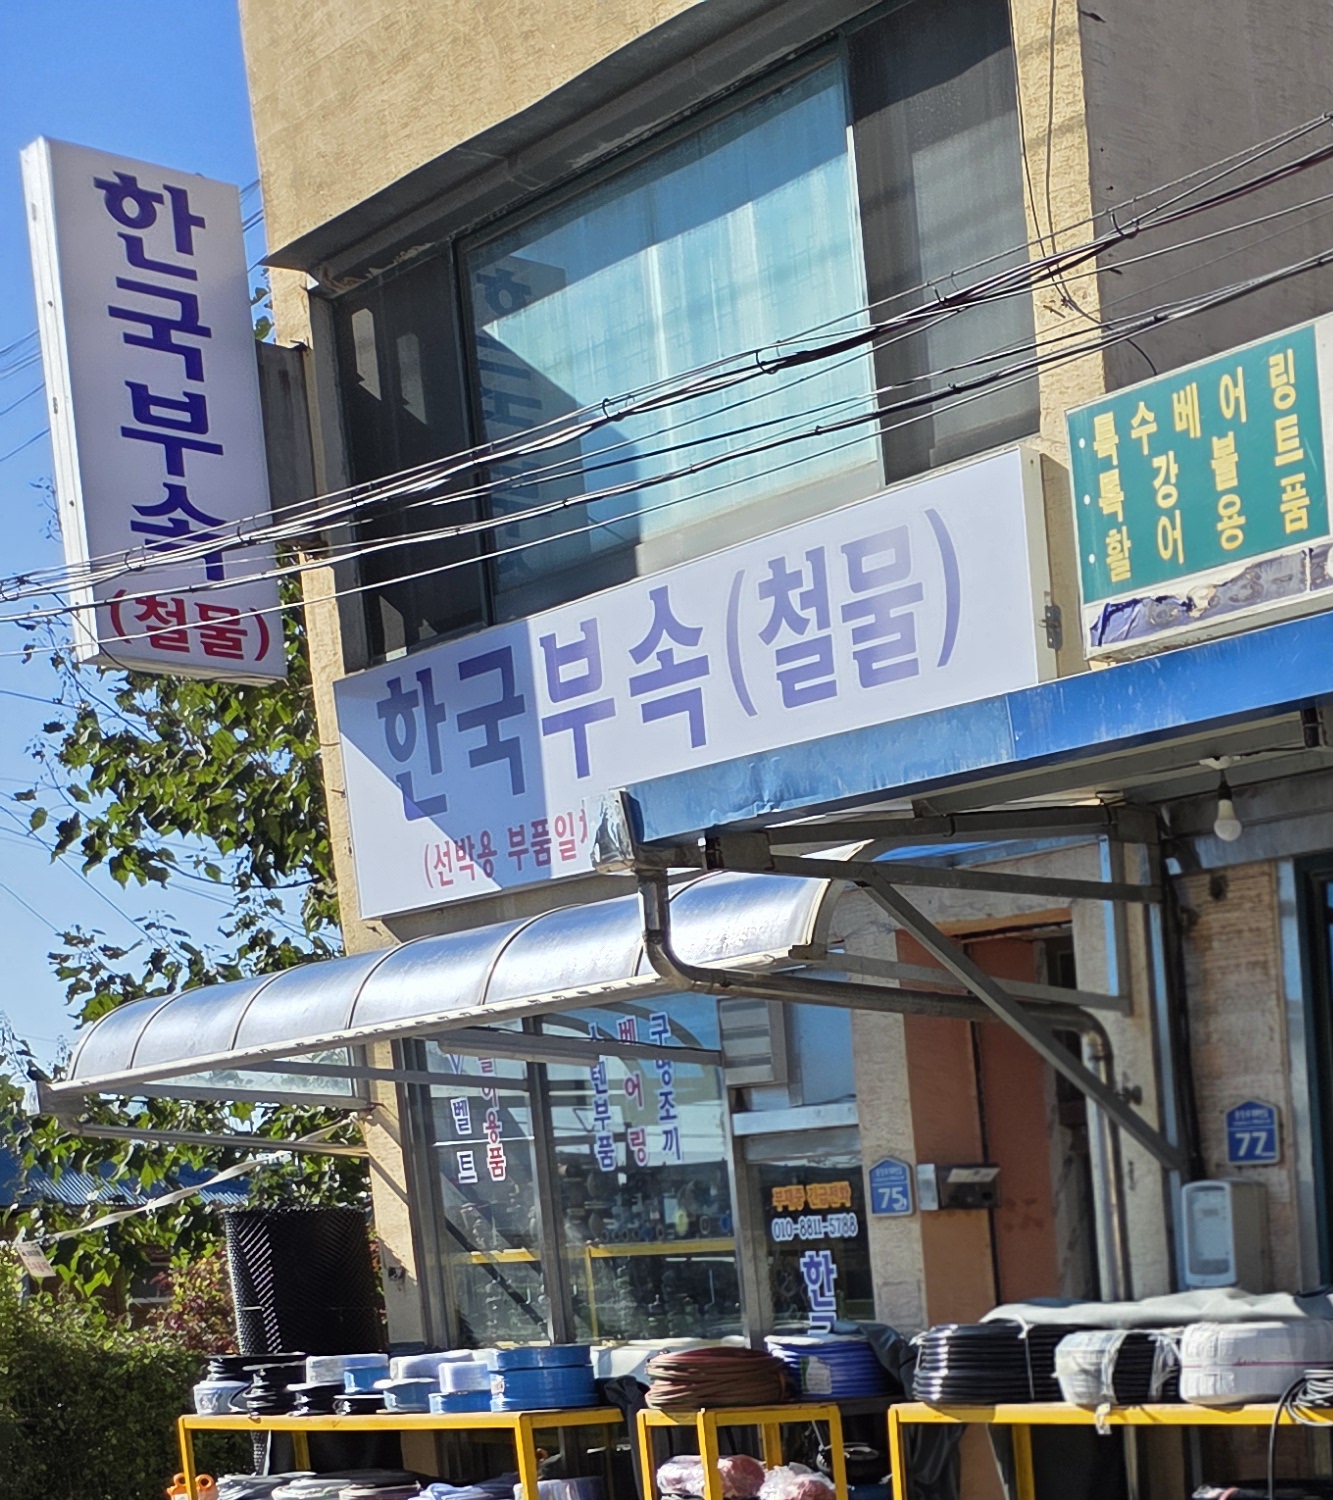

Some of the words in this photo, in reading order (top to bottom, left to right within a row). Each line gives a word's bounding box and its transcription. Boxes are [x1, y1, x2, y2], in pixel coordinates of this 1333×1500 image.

[93, 170, 227, 582] 한국부속
[1093, 348, 1297, 466] 특수베어링
[1105, 472, 1310, 583] 활어용품
[109, 587, 271, 662] (철물)
[376, 508, 962, 821] 한국부속(철물)
[424, 829, 498, 888] (선박용
[616, 1014, 649, 1167] 베어링
[1235, 1131, 1268, 1157] 77
[771, 1212, 859, 1242] 010-8811-5788
[877, 1186, 905, 1211] 75
